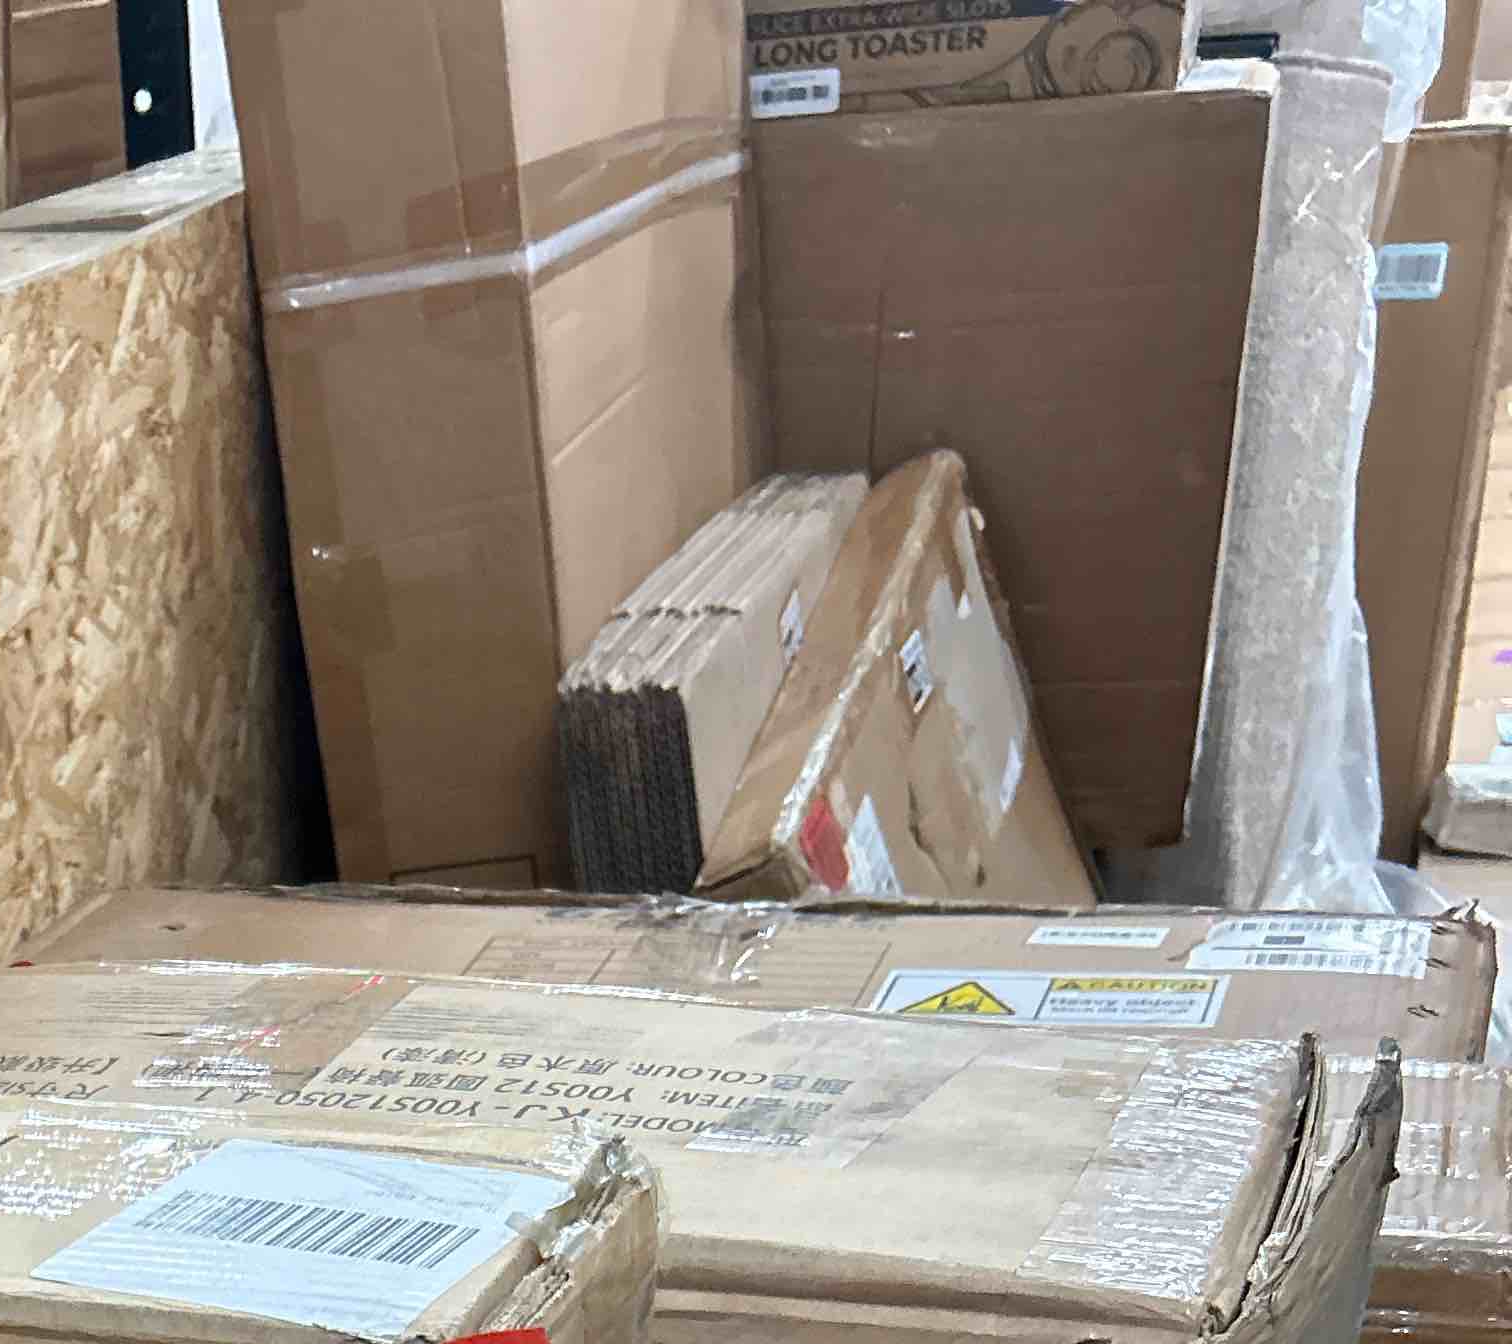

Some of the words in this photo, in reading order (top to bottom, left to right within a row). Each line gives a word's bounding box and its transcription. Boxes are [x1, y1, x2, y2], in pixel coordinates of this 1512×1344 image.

[752, 38, 839, 68] LONG
[846, 26, 988, 60] TOASTER
[1087, 978, 1209, 992] CAUTION
[494, 1078, 636, 1103] Y00S12
